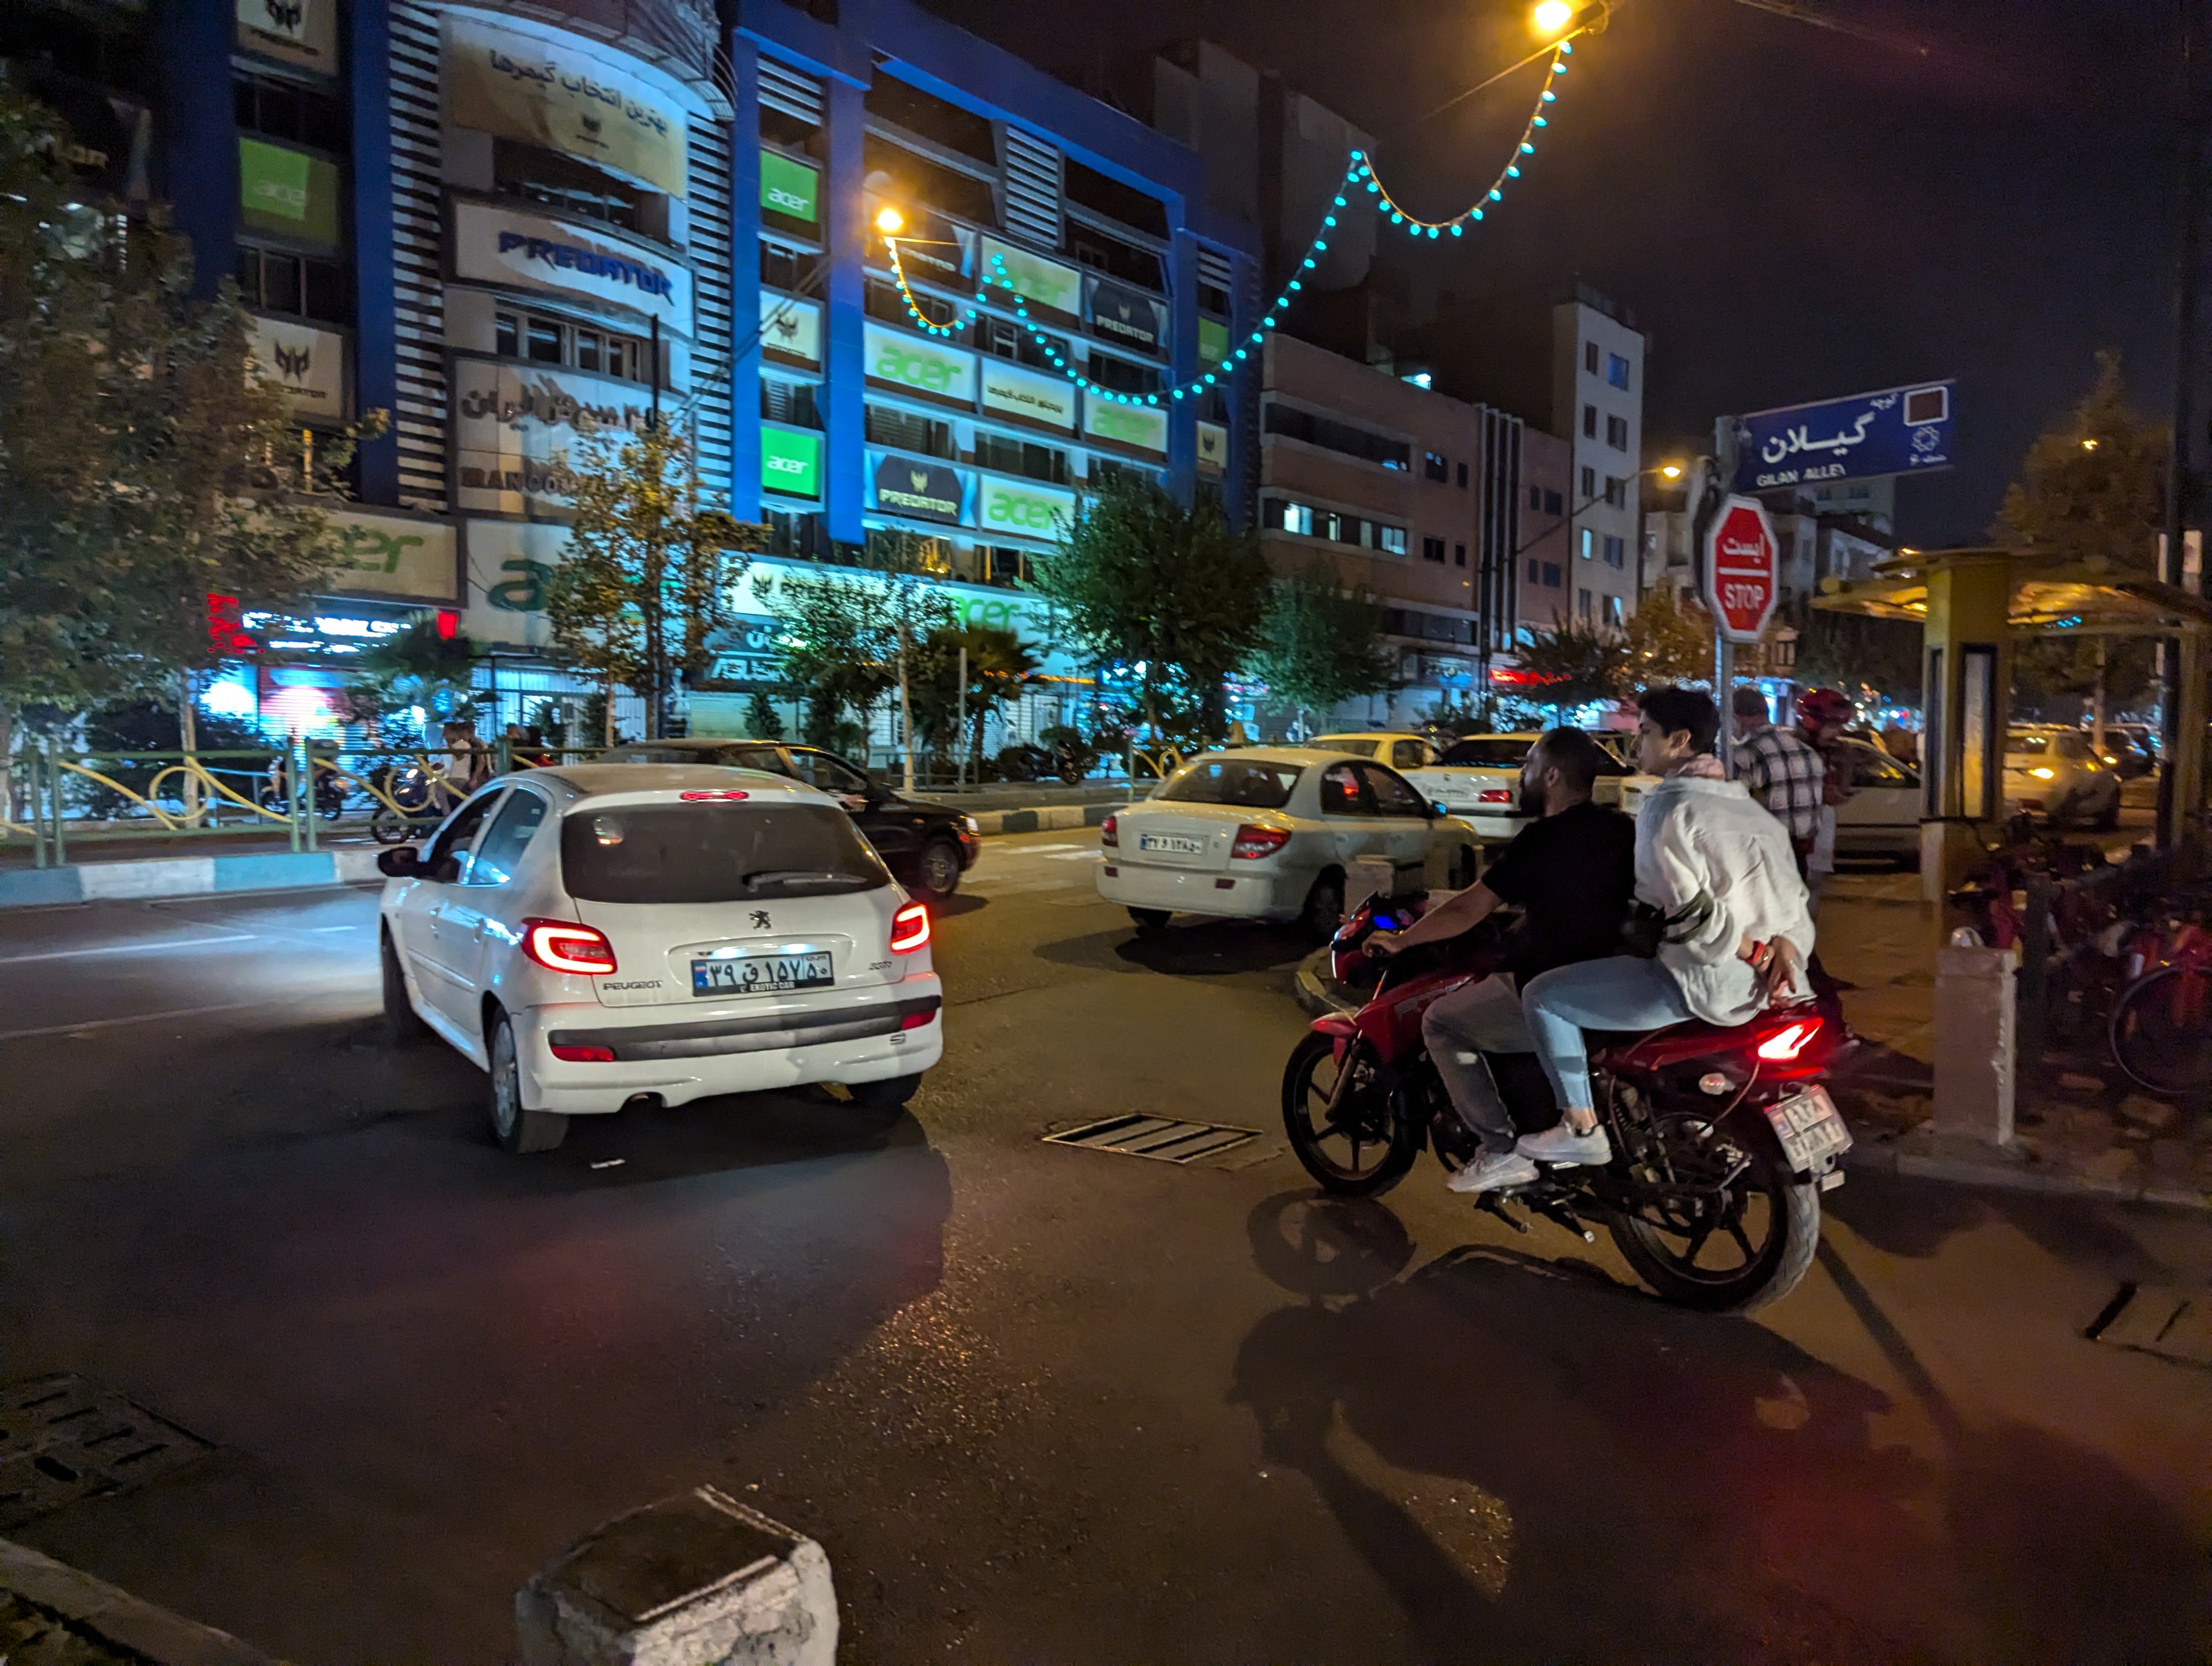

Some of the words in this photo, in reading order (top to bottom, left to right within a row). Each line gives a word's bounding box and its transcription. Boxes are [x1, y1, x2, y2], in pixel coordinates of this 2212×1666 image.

[488, 48, 557, 90] گیمرها
[560, 75, 622, 110] انتخاب
[625, 99, 667, 139] بهترین
[767, 187, 810, 212] acer
[498, 230, 676, 307] PREDATOR
[1096, 314, 1154, 344] PREDATOR
[876, 345, 961, 393] acer
[766, 454, 809, 476] acer
[1756, 469, 1799, 487] GILAN
[1803, 463, 1847, 480] ALLEY
[878, 488, 959, 517] PREDATOR
[988, 491, 1062, 530] acer
[1721, 533, 1766, 565] ایست
[1724, 582, 1765, 610] STOP
[603, 980, 663, 990] PEUGEOT
